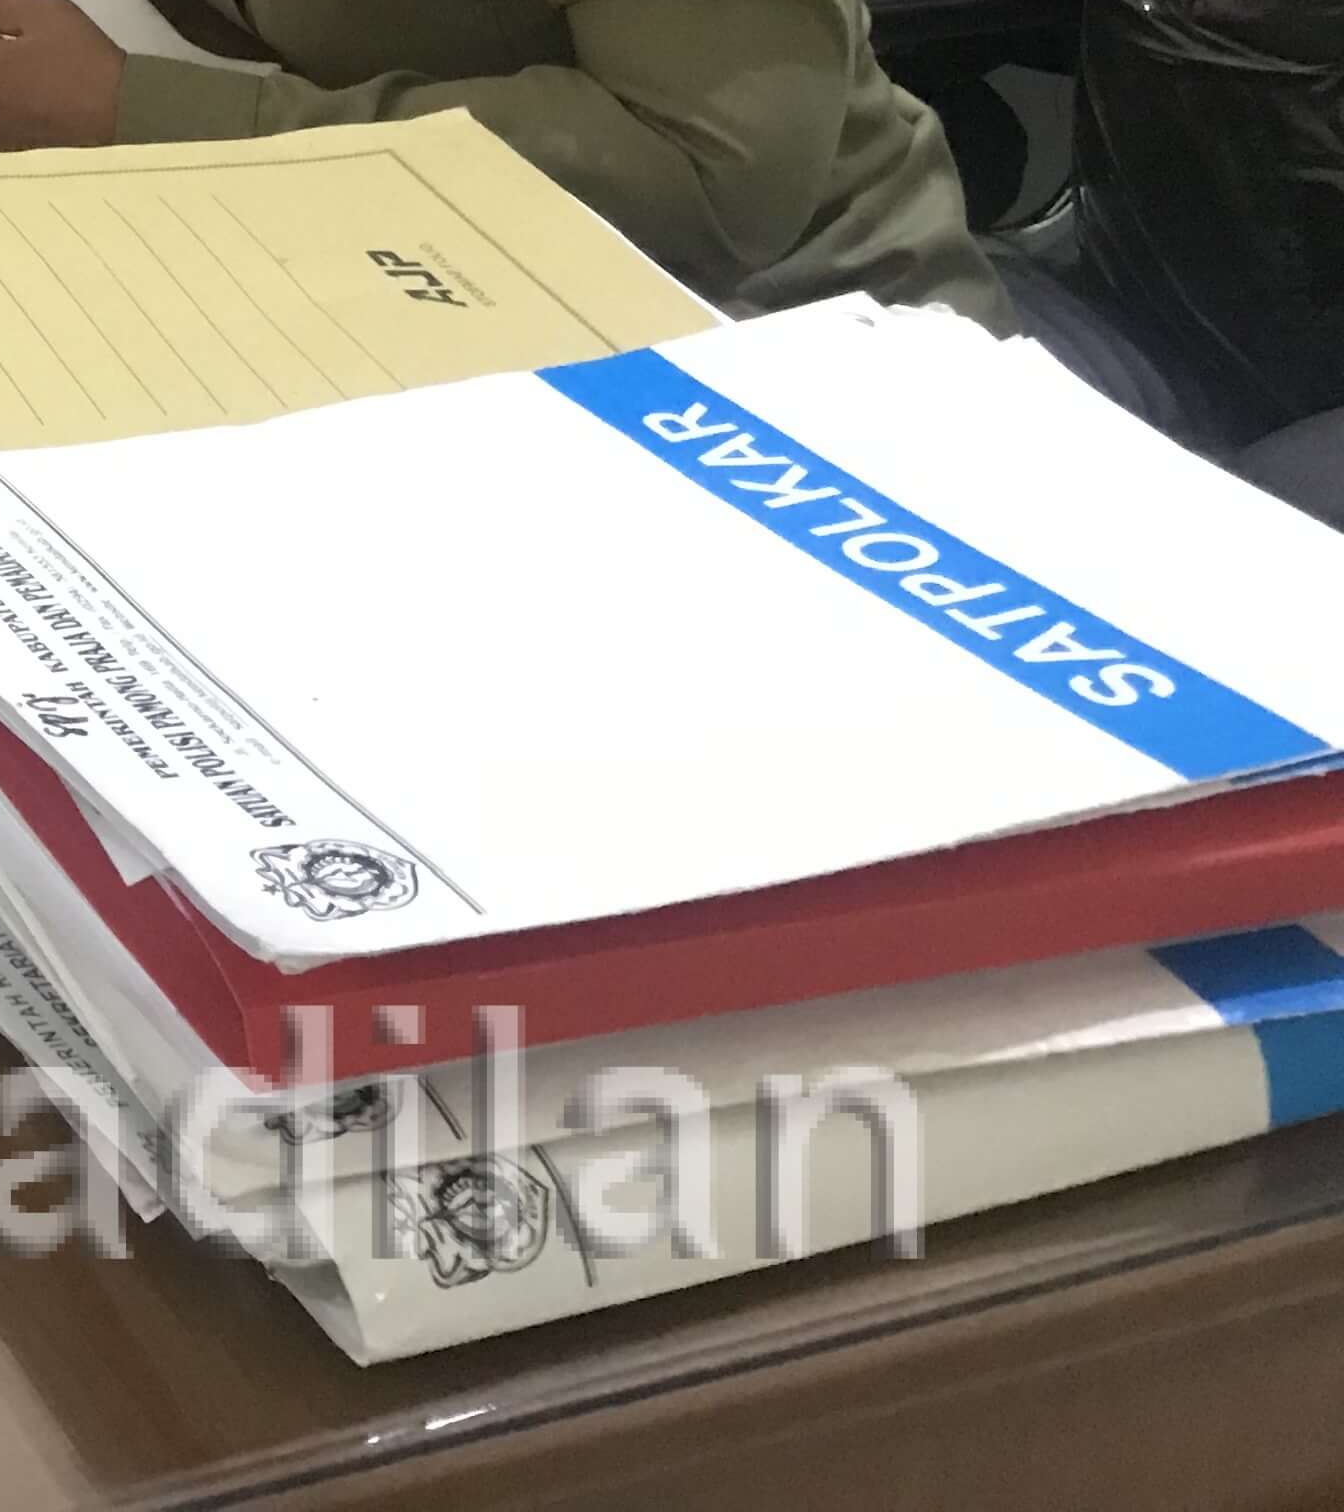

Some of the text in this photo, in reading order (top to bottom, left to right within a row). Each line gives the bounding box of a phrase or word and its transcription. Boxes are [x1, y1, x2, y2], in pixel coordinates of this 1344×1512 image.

[365, 249, 467, 308] AJP
[641, 401, 1178, 710] SATPOLKAR
[37, 605, 81, 630] DAN
[64, 632, 124, 672] PRAJA
[107, 676, 183, 728] PAMONG
[67, 682, 177, 778] PEMERINTAH
[165, 732, 233, 776] POLISI
[218, 781, 295, 827] SATUAN
